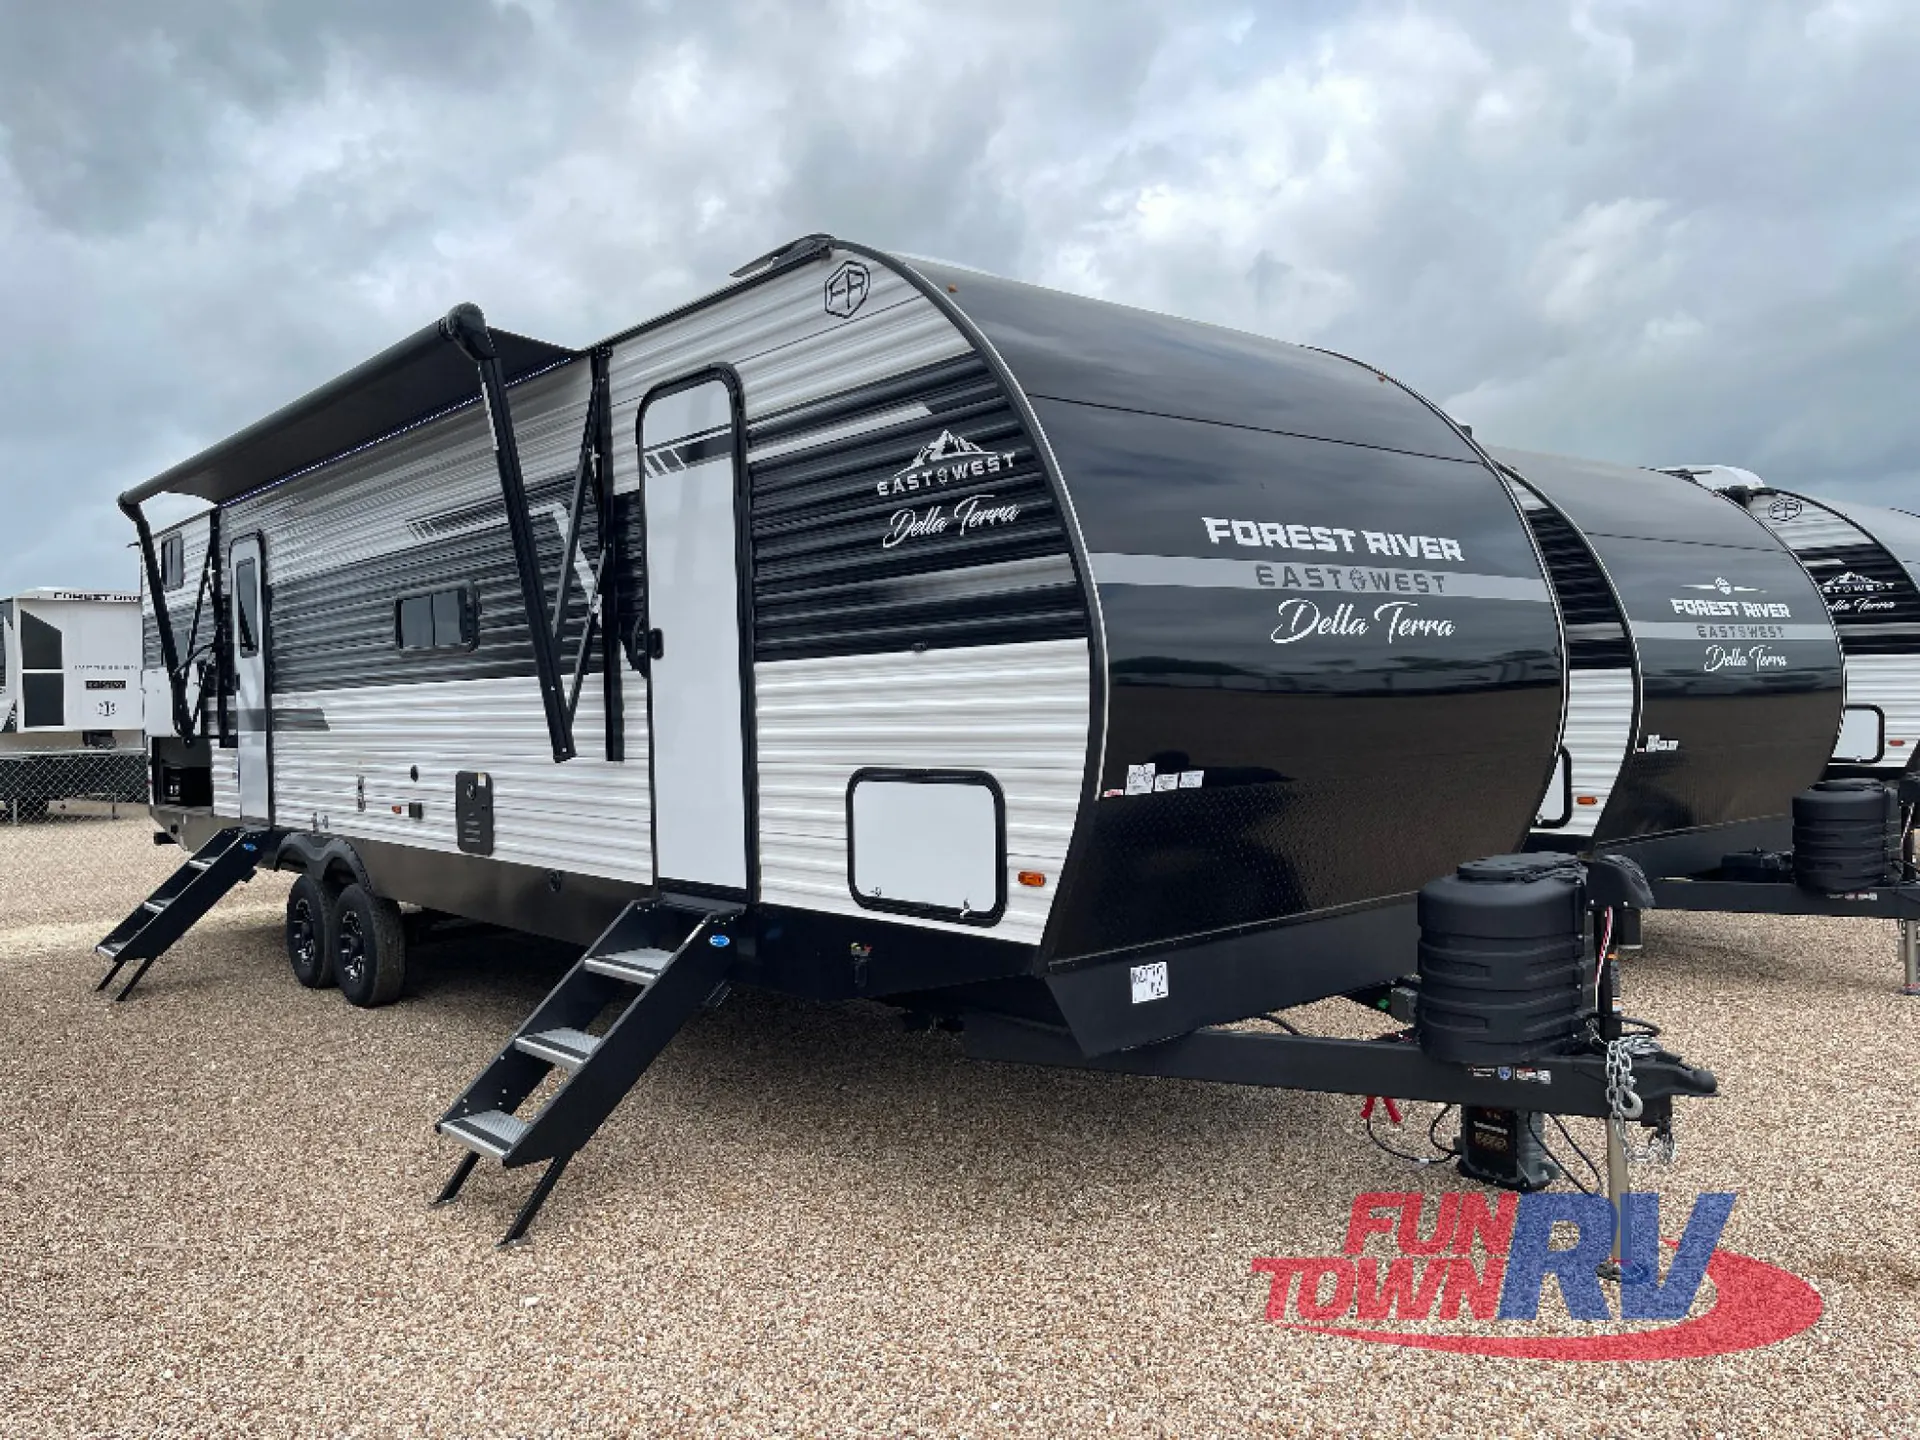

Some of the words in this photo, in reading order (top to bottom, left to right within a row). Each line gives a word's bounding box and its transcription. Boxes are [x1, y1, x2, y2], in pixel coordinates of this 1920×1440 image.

[883, 506, 948, 548] Della
[954, 494, 1021, 536] Terra
[1201, 516, 1356, 553] FOREST
[1360, 530, 1465, 562] RIVER
[1270, 598, 1369, 644] Della
[1374, 601, 1456, 644] Terra
[1669, 599, 1739, 616] FOREST
[1741, 602, 1791, 618] RIVER
[1704, 644, 1748, 672] Della
[1749, 644, 1787, 672] Terra
